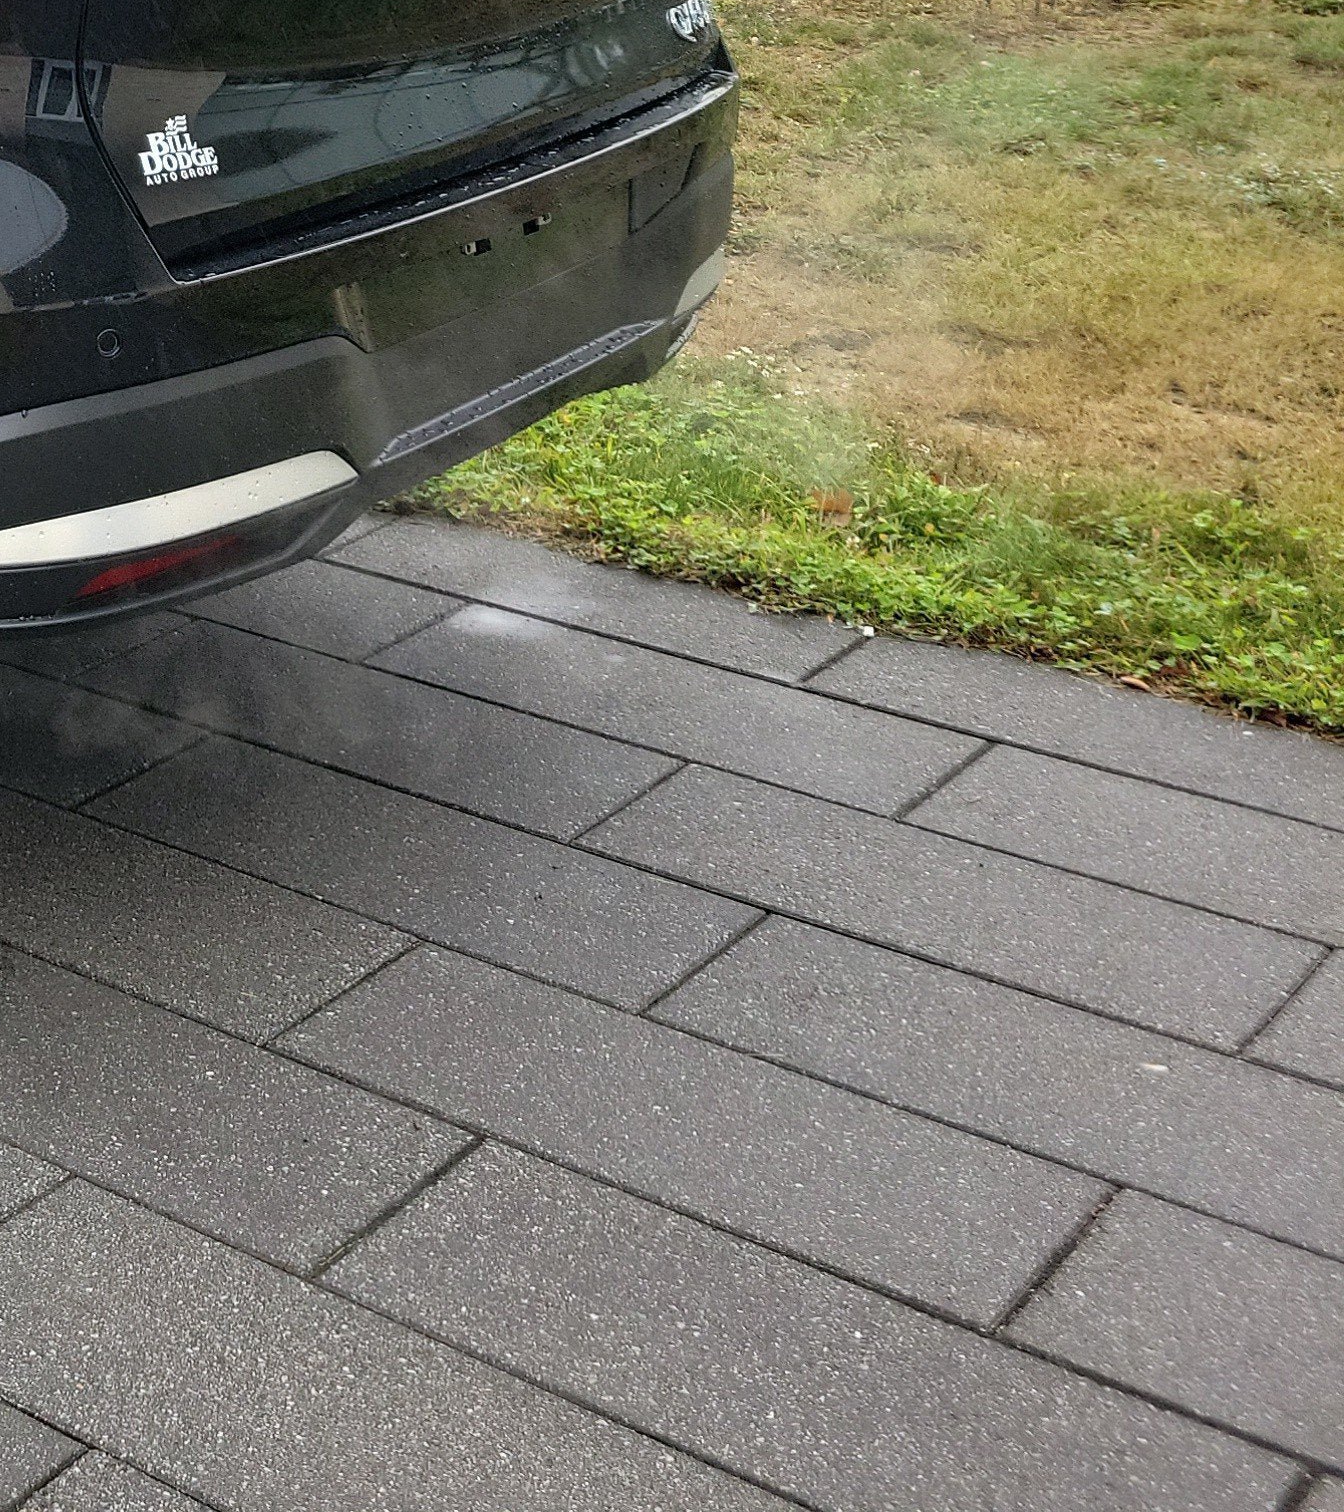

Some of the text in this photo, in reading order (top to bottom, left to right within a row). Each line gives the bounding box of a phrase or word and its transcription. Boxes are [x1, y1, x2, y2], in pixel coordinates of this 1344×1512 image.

[146, 132, 198, 156] BILL
[138, 146, 218, 176] DODGE
[146, 164, 219, 186] AUTO GROUP
